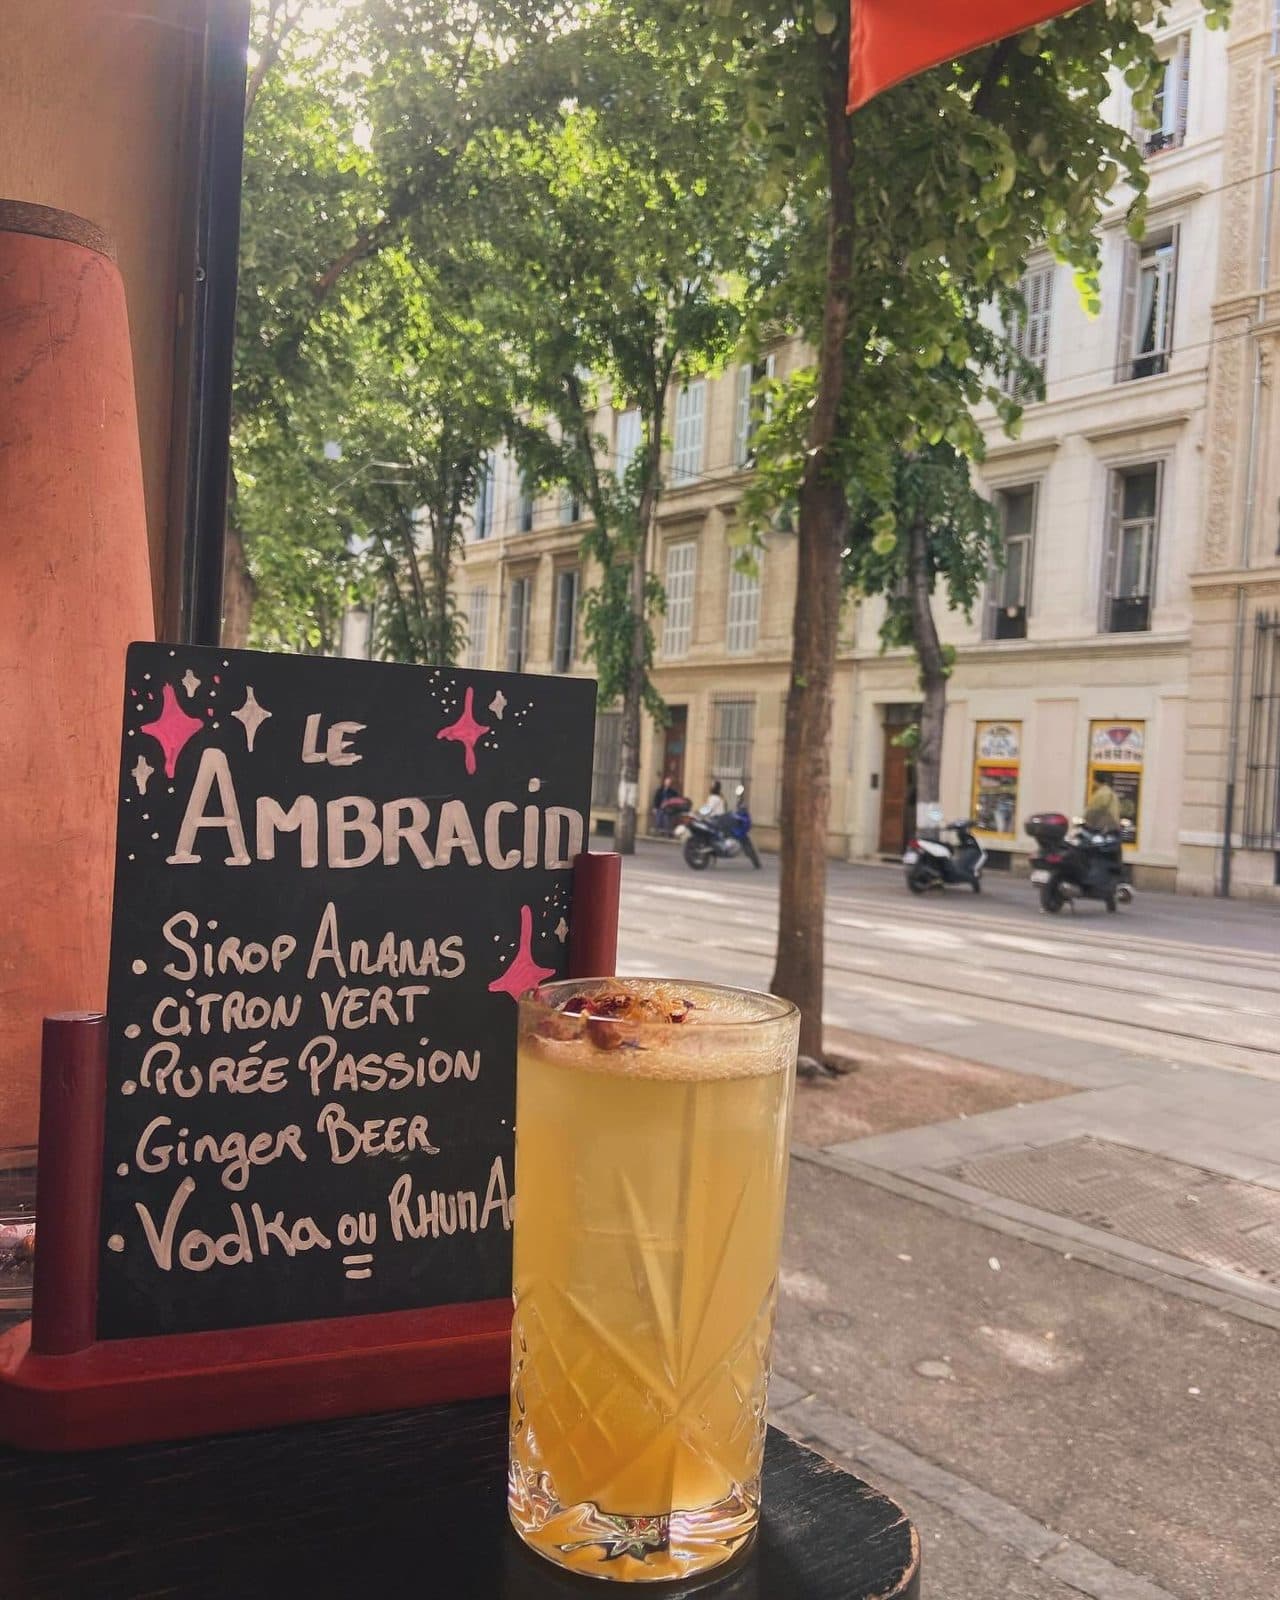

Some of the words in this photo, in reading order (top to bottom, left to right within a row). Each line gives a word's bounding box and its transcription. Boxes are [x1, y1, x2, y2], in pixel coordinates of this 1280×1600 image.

[303, 713, 367, 766] LE
[321, 986, 430, 1031] VERT
[140, 1041, 290, 1098] PURÉE
[317, 1102, 440, 1165] BEER
[135, 1176, 332, 1271] Vodka
